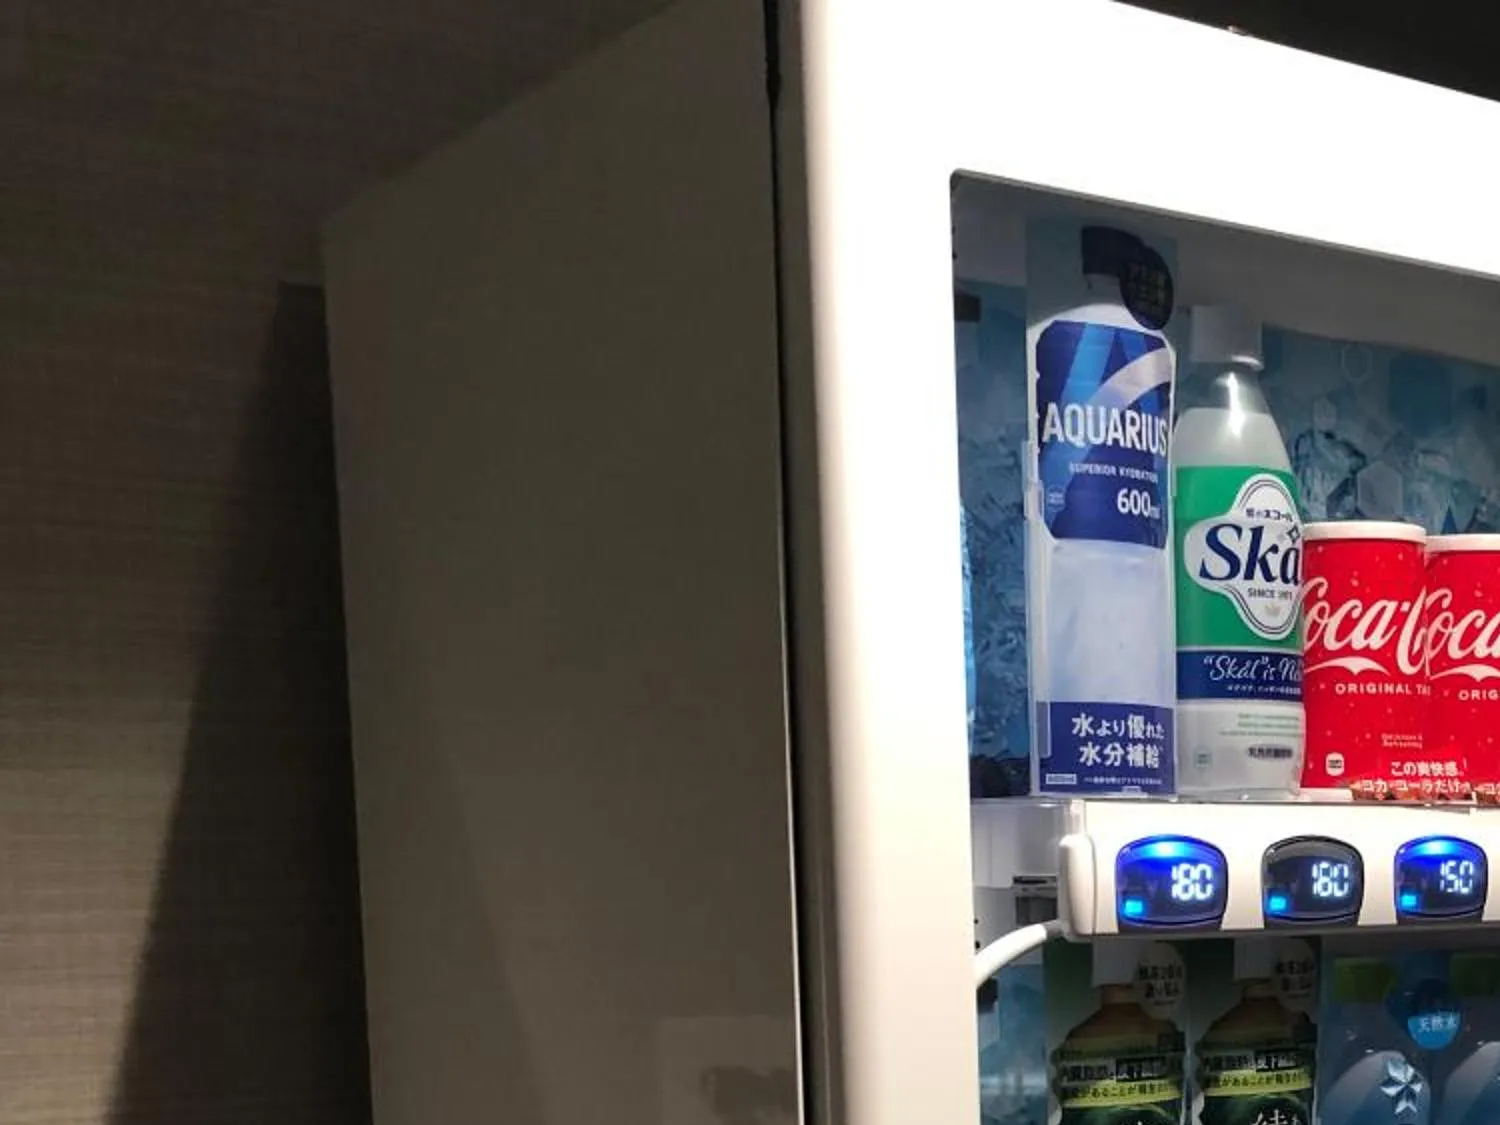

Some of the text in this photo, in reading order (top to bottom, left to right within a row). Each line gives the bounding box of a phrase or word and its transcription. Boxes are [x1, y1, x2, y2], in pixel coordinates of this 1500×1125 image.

[1042, 402, 1168, 457] AQUARIUS
[1335, 683, 1412, 696] ORIGINAL
[1072, 712, 1166, 741] 水より優れた
[1079, 741, 1161, 770] 水分補給
[1171, 863, 1213, 901] 180
[1312, 861, 1349, 897] 180
[1440, 860, 1475, 894] 150
